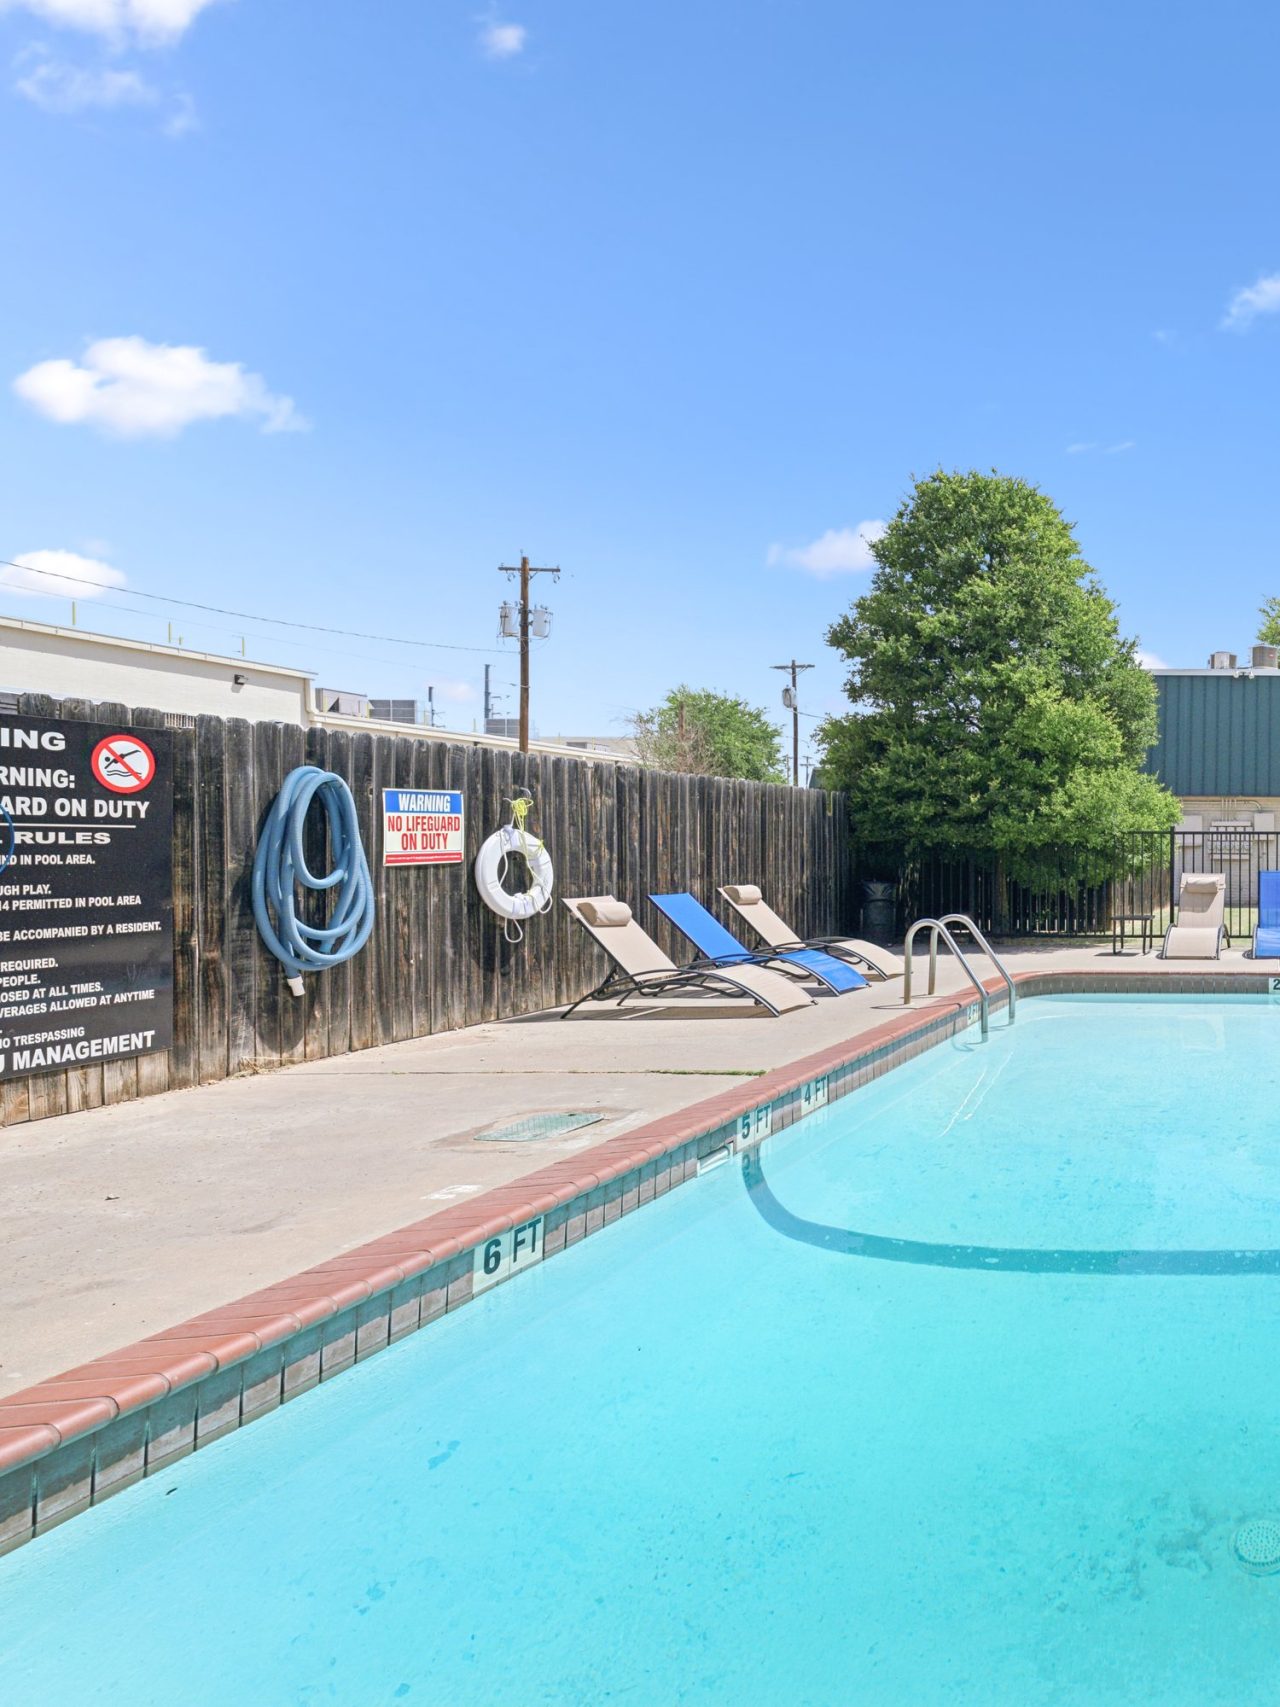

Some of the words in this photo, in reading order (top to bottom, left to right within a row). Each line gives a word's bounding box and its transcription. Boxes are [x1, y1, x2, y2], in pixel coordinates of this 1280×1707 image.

[54, 798, 87, 817] ON
[94, 800, 149, 819] DUTY
[398, 793, 451, 812] WARNING
[387, 816, 402, 832] NO
[406, 815, 460, 832] LIFEGUARD
[14, 831, 111, 845] RULES
[401, 833, 417, 850] ON
[421, 833, 448, 850] DUTY
[20, 854, 32, 865] IN
[35, 854, 63, 865] POOL
[65, 854, 95, 865] AREA.
[23, 884, 52, 895] PLAY.
[12, 898, 73, 910] PERMITTED
[75, 897, 86, 908] IN
[88, 896, 115, 907] POOL
[117, 895, 141, 906] AREA
[13, 926, 88, 941] ACCOMPANIED
[90, 924, 104, 936] BY
[106, 924, 114, 934] A
[116, 921, 162, 934] RESIDENT.
[1, 957, 58, 972] REQUIRED.
[32, 987, 46, 999] AT
[49, 985, 68, 997] ALL
[71, 982, 104, 994] TIMES.
[1273, 979, 1280, 990] 2
[50, 997, 97, 1012] ALLOWED
[99, 994, 112, 1006] AT
[113, 989, 155, 1004] ANYTIME
[13, 1027, 85, 1047] TRESPASSING
[13, 1030, 155, 1071] MANAGEMENT
[804, 1083, 811, 1105] 4
[815, 1075, 827, 1101] FT
[742, 1113, 750, 1139] 5
[756, 1104, 770, 1133] FT
[483, 1238, 501, 1275] 6
[513, 1217, 542, 1263] FT
